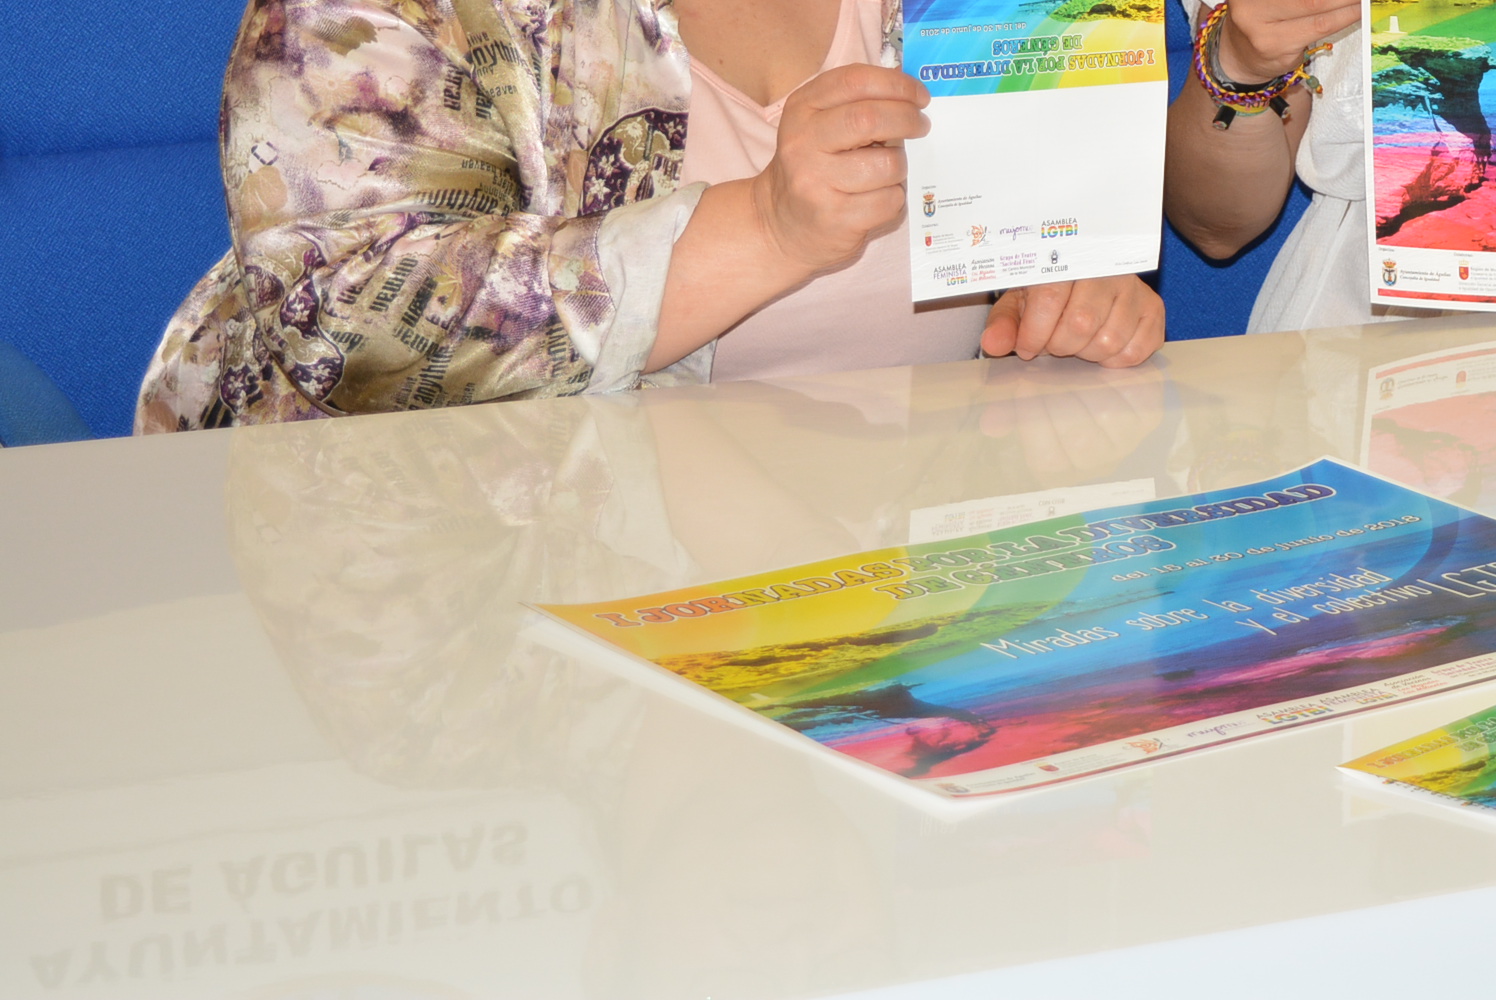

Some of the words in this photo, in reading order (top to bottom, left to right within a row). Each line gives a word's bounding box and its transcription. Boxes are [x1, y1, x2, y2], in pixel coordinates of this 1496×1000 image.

[941, 27, 951, 35] de
[951, 25, 972, 35] junio
[972, 25, 982, 33] de
[983, 24, 993, 32] 30
[995, 23, 1004, 32] al
[1003, 23, 1013, 31] 15
[1014, 22, 1027, 30] del
[920, 28, 940, 37] 2018
[992, 36, 1060, 57] GÉNEROS
[1061, 34, 1084, 50] DE
[1035, 55, 1067, 73] POR
[1068, 50, 1145, 72] JORNADAS
[919, 59, 1012, 82] DIVERSIDAD
[1012, 58, 1035, 75] LA
[1042, 217, 1078, 227] ASAMBLEA
[1041, 224, 1078, 239] LGTBI
[933, 263, 967, 273] ASAMBLEA
[1055, 264, 1069, 273] CLUB
[933, 269, 968, 280] FEMINISTA
[946, 276, 968, 286] LGTBI
[1110, 568, 1152, 583] del
[1153, 560, 1184, 576] 15
[1184, 556, 1210, 568] al
[1208, 551, 1246, 563] 30
[1247, 544, 1276, 557] de
[1273, 535, 1336, 556] junio
[1335, 526, 1366, 539] de
[1363, 514, 1423, 532] 2018
[596, 612, 641, 628] I
[637, 562, 905, 624] JORNADAS
[996, 531, 1080, 561] LA
[1056, 483, 1338, 544] DIVERSIDAD
[980, 621, 1121, 660] Miradas
[1125, 605, 1211, 632] sobre
[1202, 597, 1254, 615] la
[1255, 566, 1393, 605] diversidad
[1234, 617, 1278, 636] y
[1272, 606, 1312, 625] el
[1312, 585, 1433, 616] colectivo
